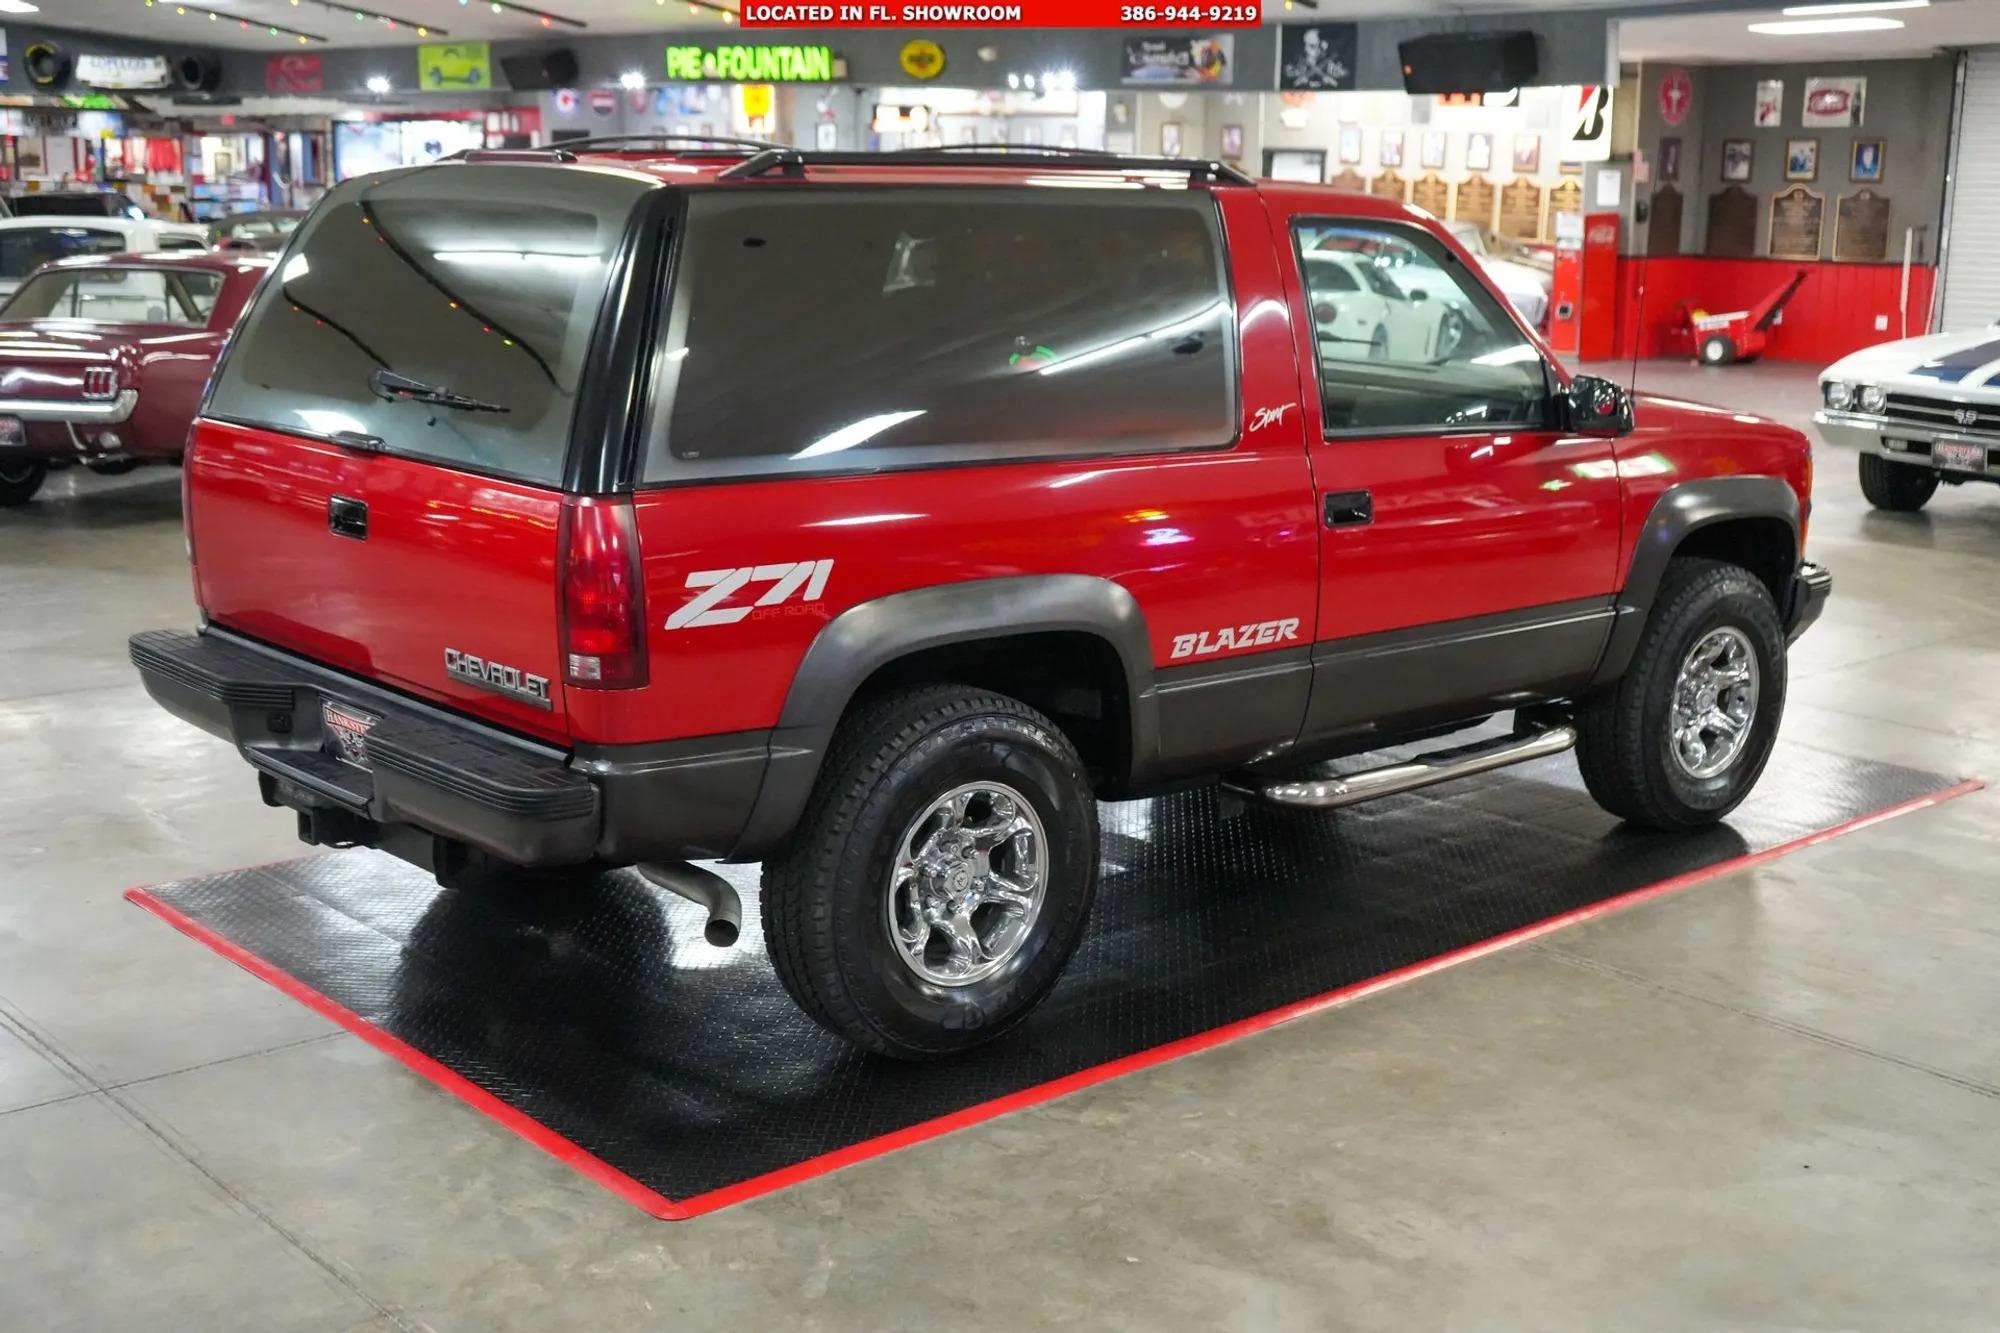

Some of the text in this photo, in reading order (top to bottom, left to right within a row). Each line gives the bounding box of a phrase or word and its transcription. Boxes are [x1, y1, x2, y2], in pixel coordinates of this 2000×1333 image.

[666, 46, 831, 80] PIE FOUNTAIN
[664, 558, 835, 631] Z71
[751, 602, 825, 621] OFF ROAD
[1170, 617, 1300, 659] BLAZER
[445, 647, 550, 700] CHEVROLET
